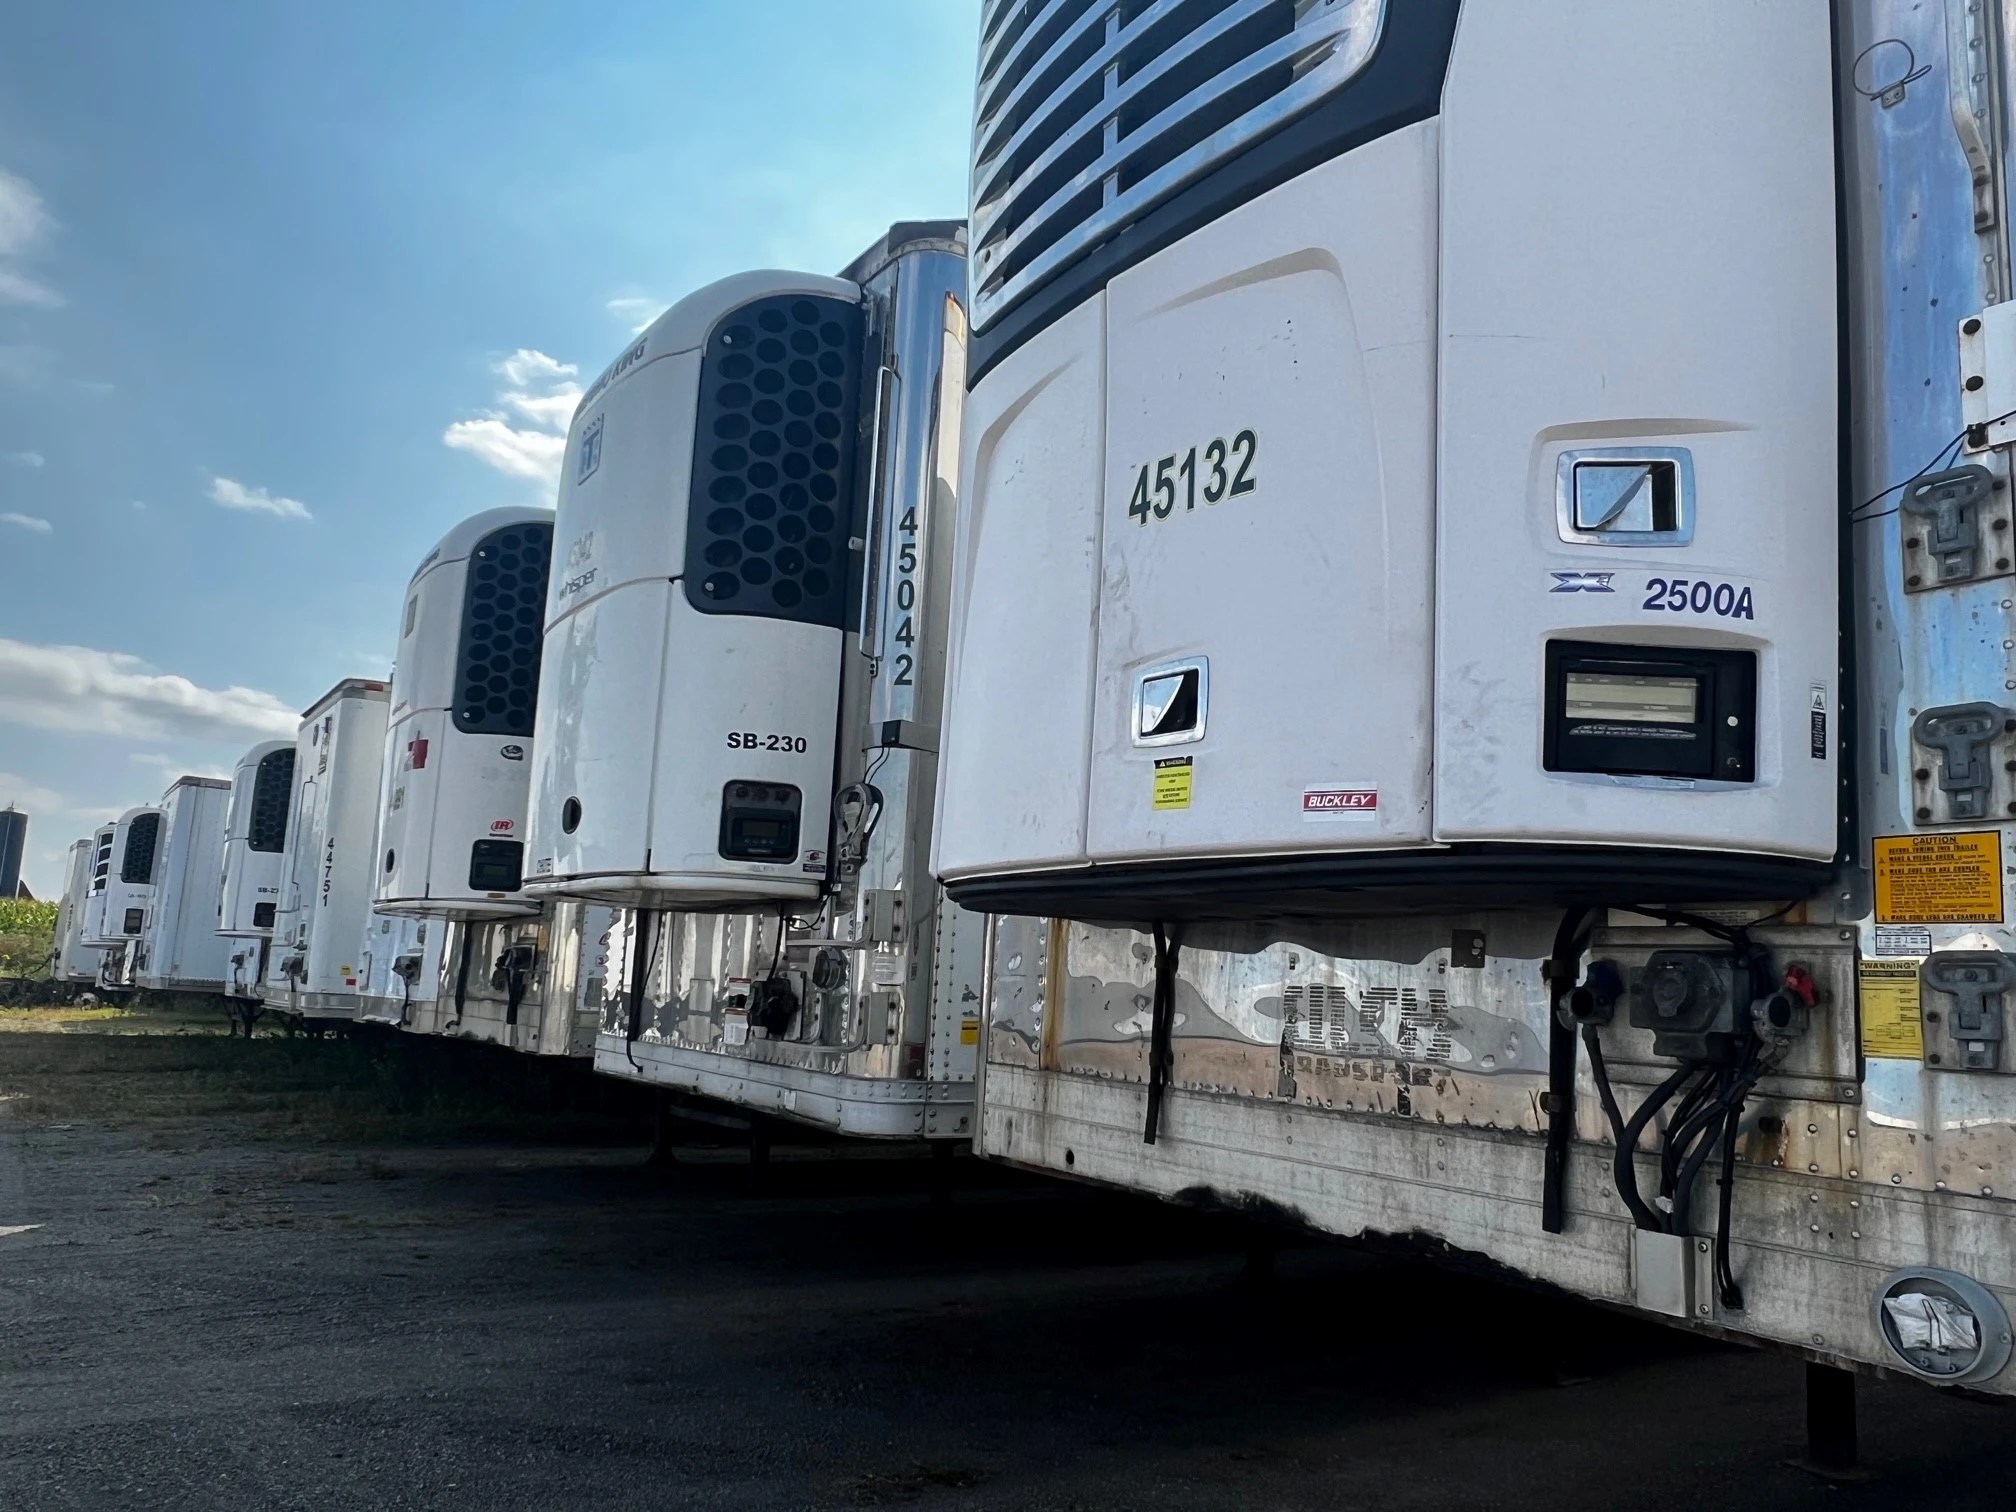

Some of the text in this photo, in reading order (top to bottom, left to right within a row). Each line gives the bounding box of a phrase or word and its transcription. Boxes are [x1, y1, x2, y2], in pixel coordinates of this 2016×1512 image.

[1128, 428, 1257, 525] 45132
[894, 506, 919, 686] 45042
[1642, 578, 1754, 620] 2500A
[727, 732, 807, 753] SB-230
[1308, 794, 1372, 807] BUCKLEY
[1912, 836, 1957, 845] CAUTION
